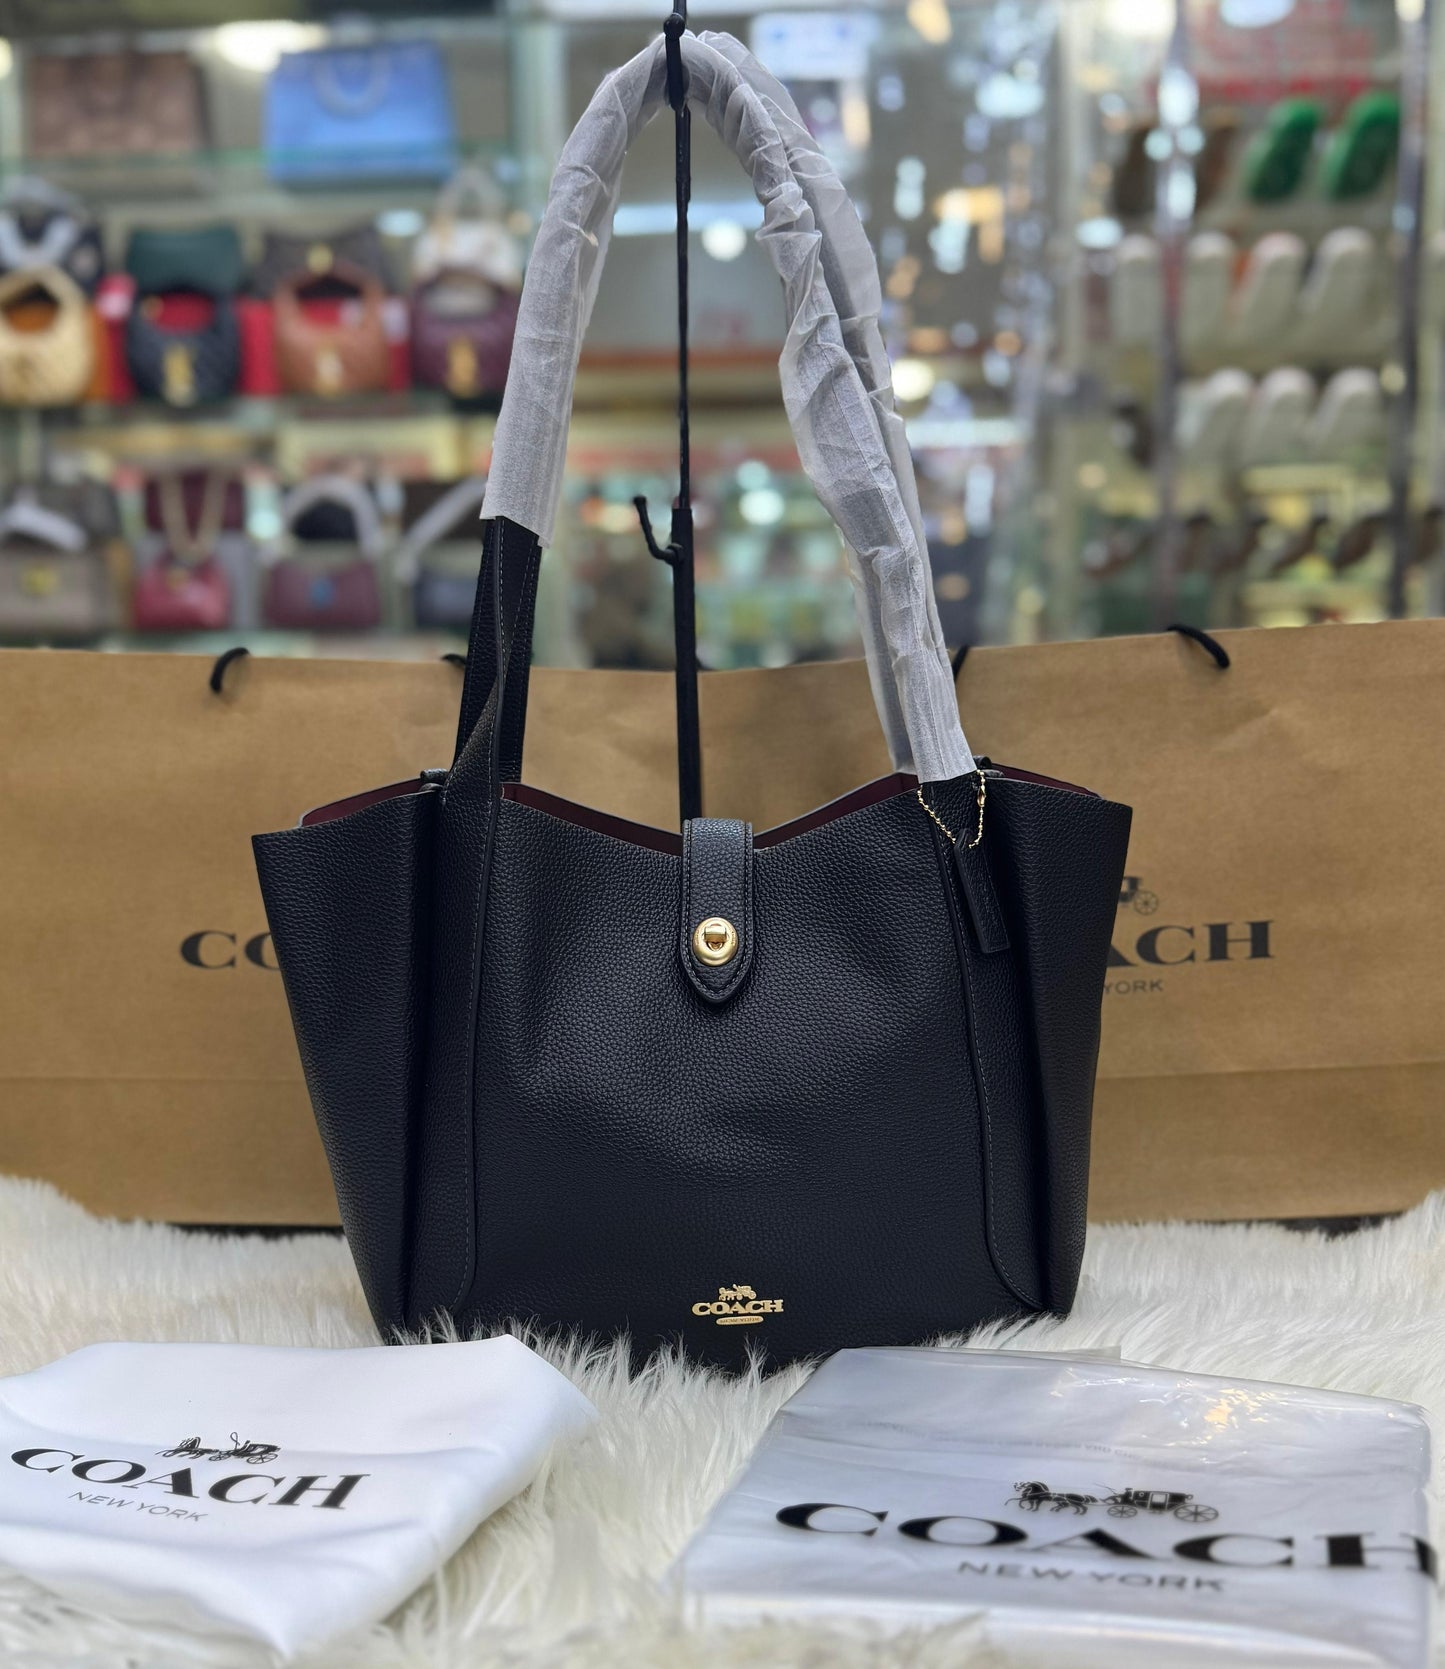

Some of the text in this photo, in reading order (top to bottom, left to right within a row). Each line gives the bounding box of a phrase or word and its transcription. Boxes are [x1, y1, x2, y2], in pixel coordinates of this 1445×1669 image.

[691, 1299, 784, 1316] COACH
[11, 1448, 371, 1510] COACH
[68, 1491, 209, 1522] NEW YORK
[775, 1502, 1438, 1581] COACH
[957, 1560, 1226, 1593] NEW YORK
